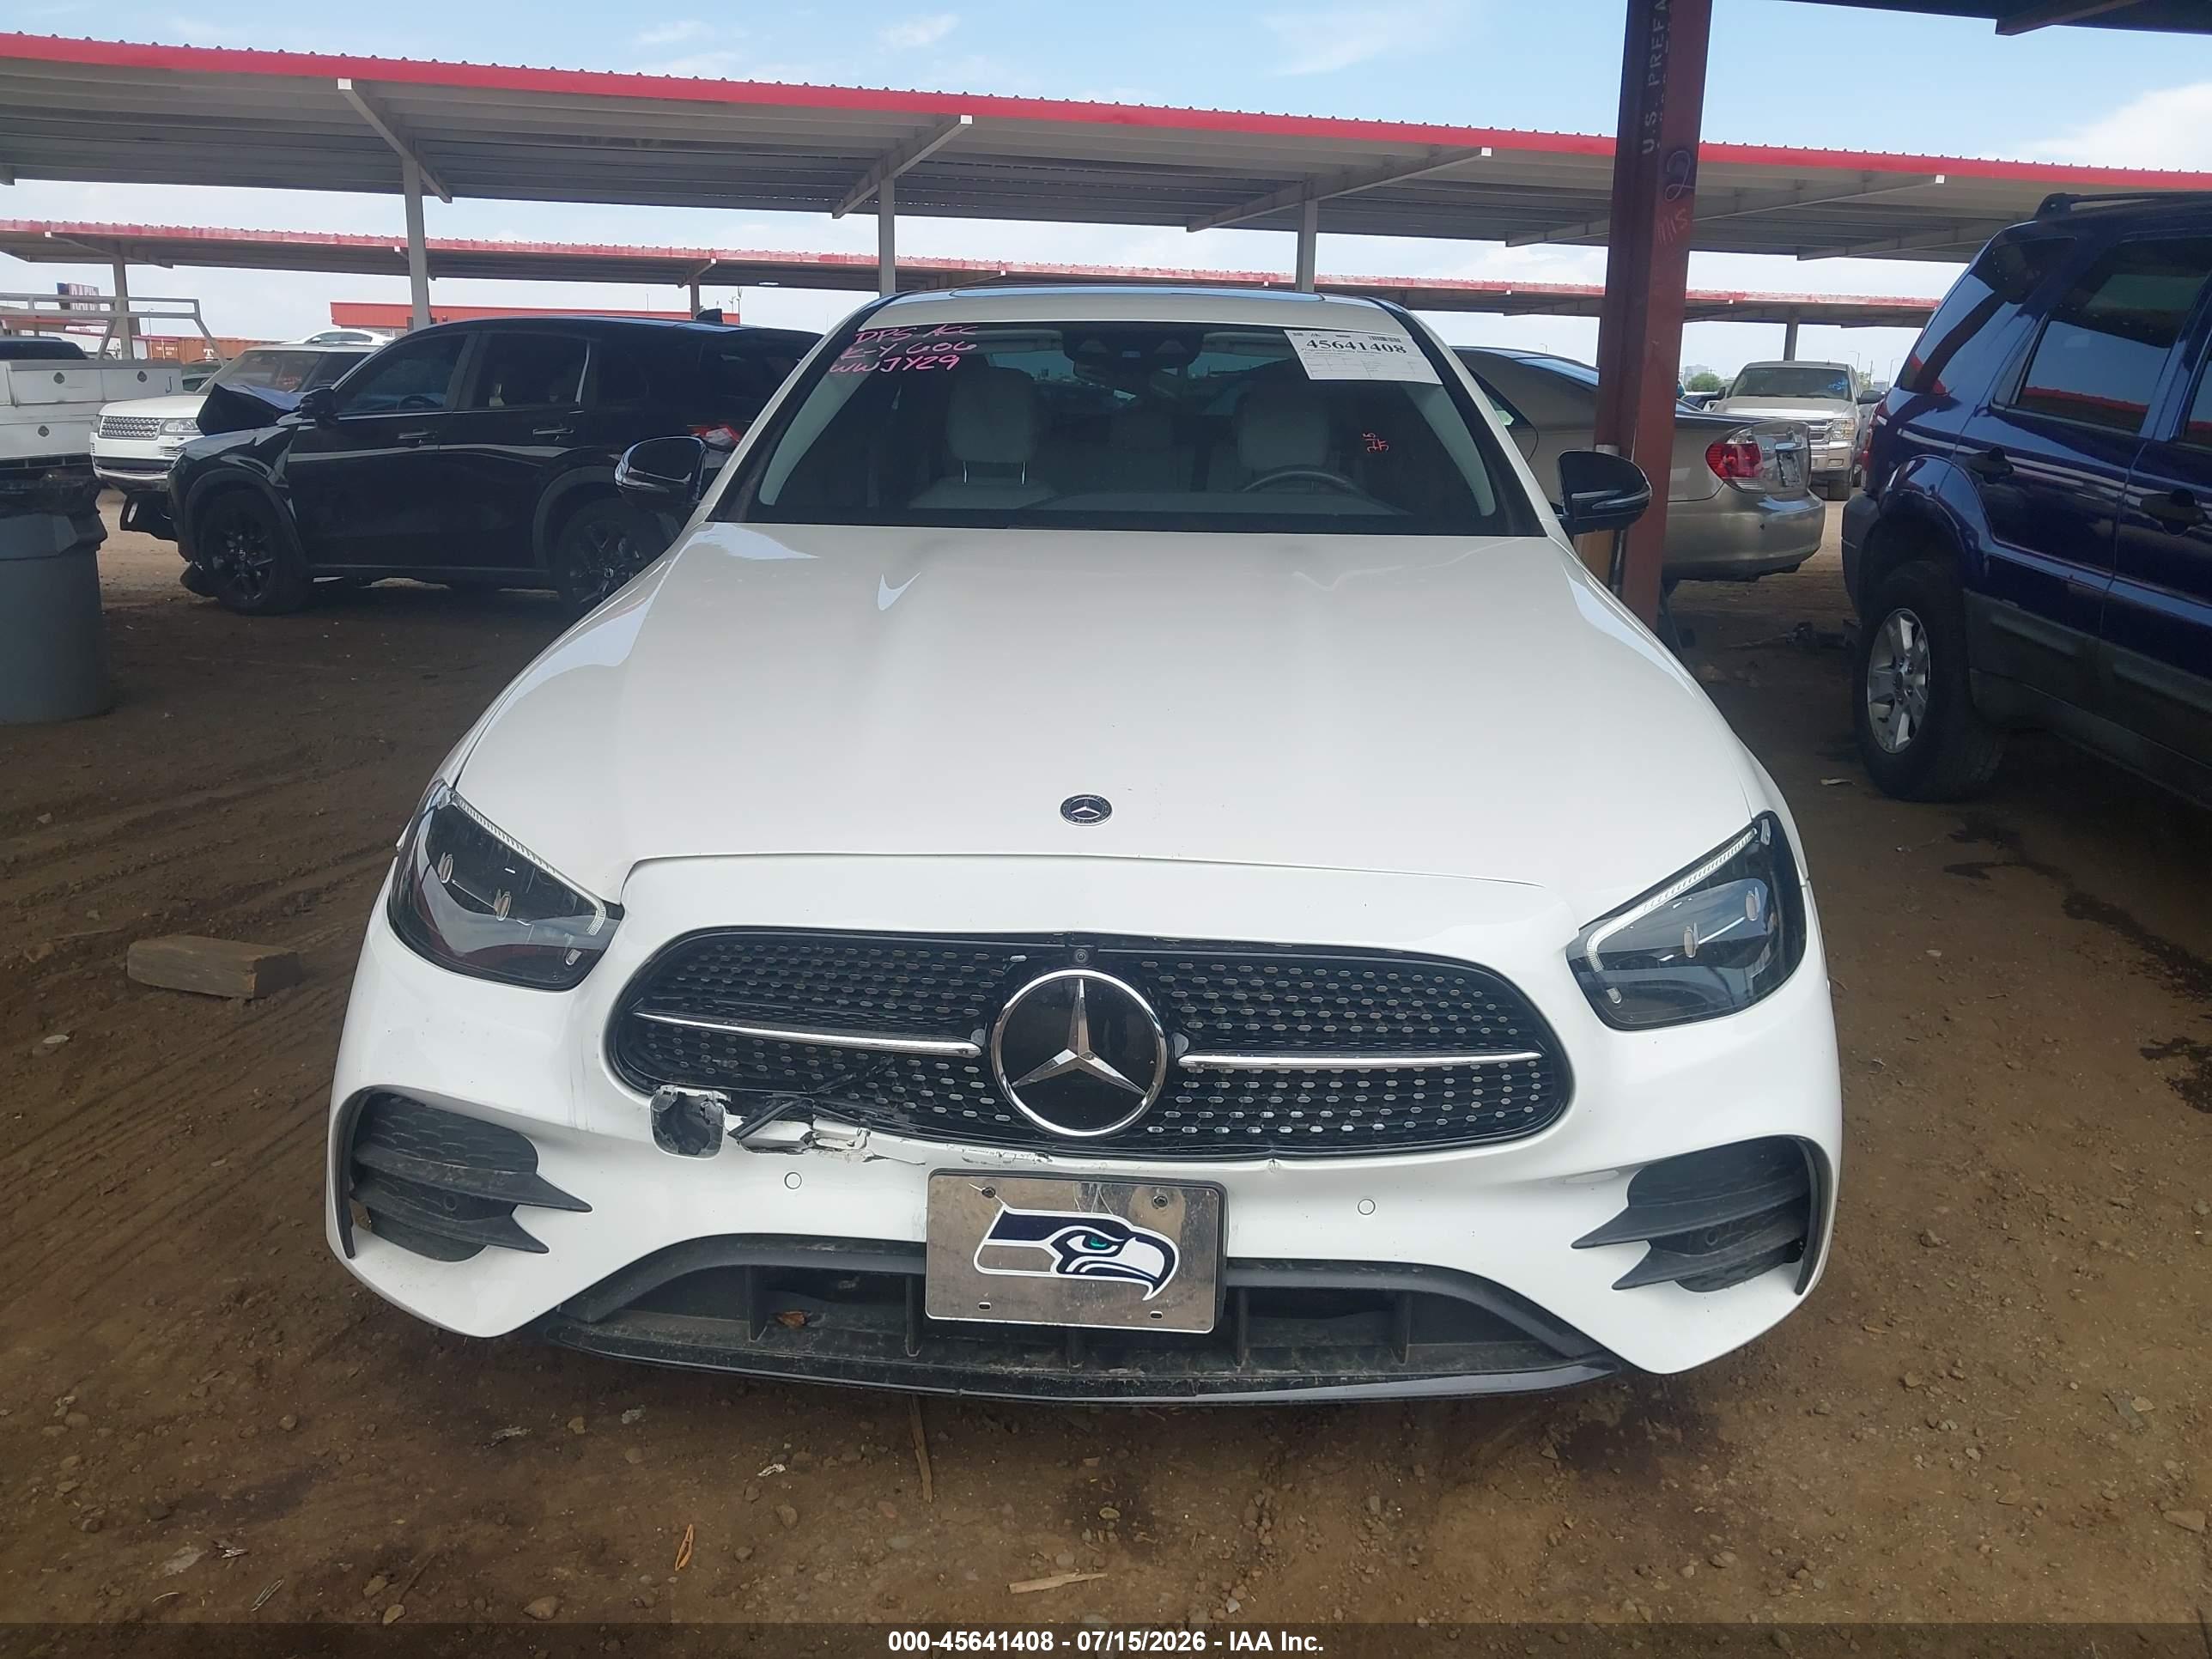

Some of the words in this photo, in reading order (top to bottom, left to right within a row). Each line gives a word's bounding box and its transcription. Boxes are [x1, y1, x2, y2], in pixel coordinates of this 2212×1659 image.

[855, 327, 917, 344] DPS
[906, 341, 977, 355] 606
[1306, 338, 1407, 354] 45641408
